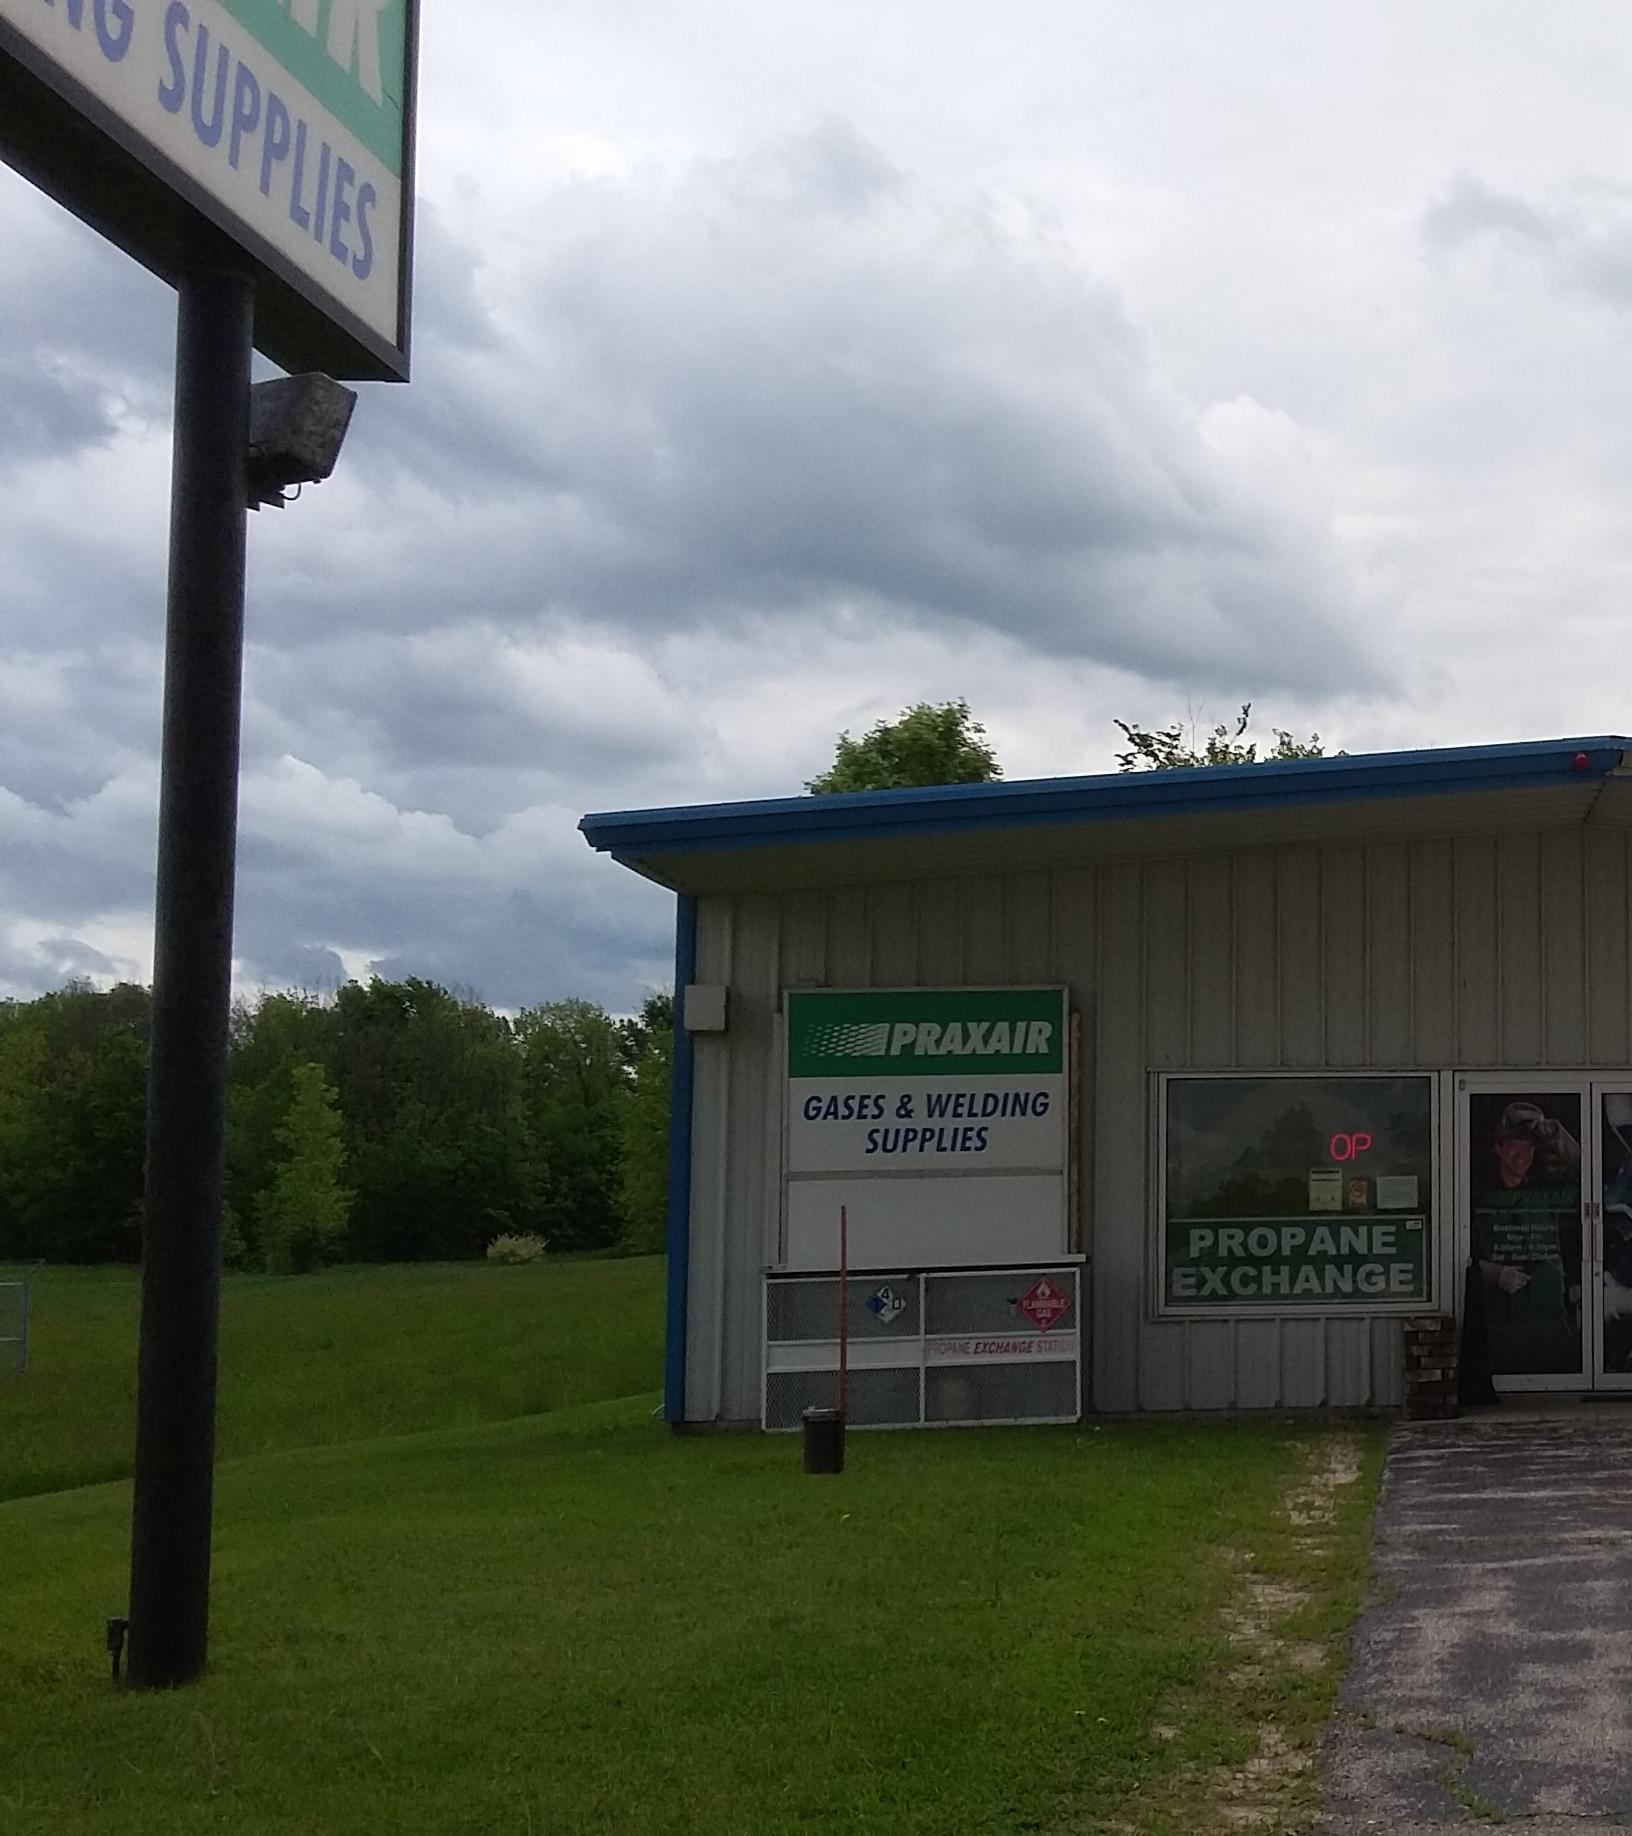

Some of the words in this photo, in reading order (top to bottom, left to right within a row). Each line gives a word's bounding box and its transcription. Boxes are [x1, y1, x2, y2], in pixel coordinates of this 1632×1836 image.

[158, 0, 377, 281] SUPPLIES
[890, 1021, 1053, 1056] PRAXAIR
[803, 1094, 886, 1121] GASES
[895, 1094, 915, 1119] &
[926, 1091, 1050, 1119] WELDING
[864, 1126, 989, 1154] SUPPLIES
[1330, 1132, 1373, 1161] OP
[1189, 1226, 1398, 1257] PROPANE
[881, 1288, 890, 1300] 4
[1172, 1263, 1415, 1297] EXCHANGE
[892, 1297, 902, 1310] 0
[1036, 1308, 1053, 1319] GAS
[973, 1340, 1034, 1355] EXCHANGE
